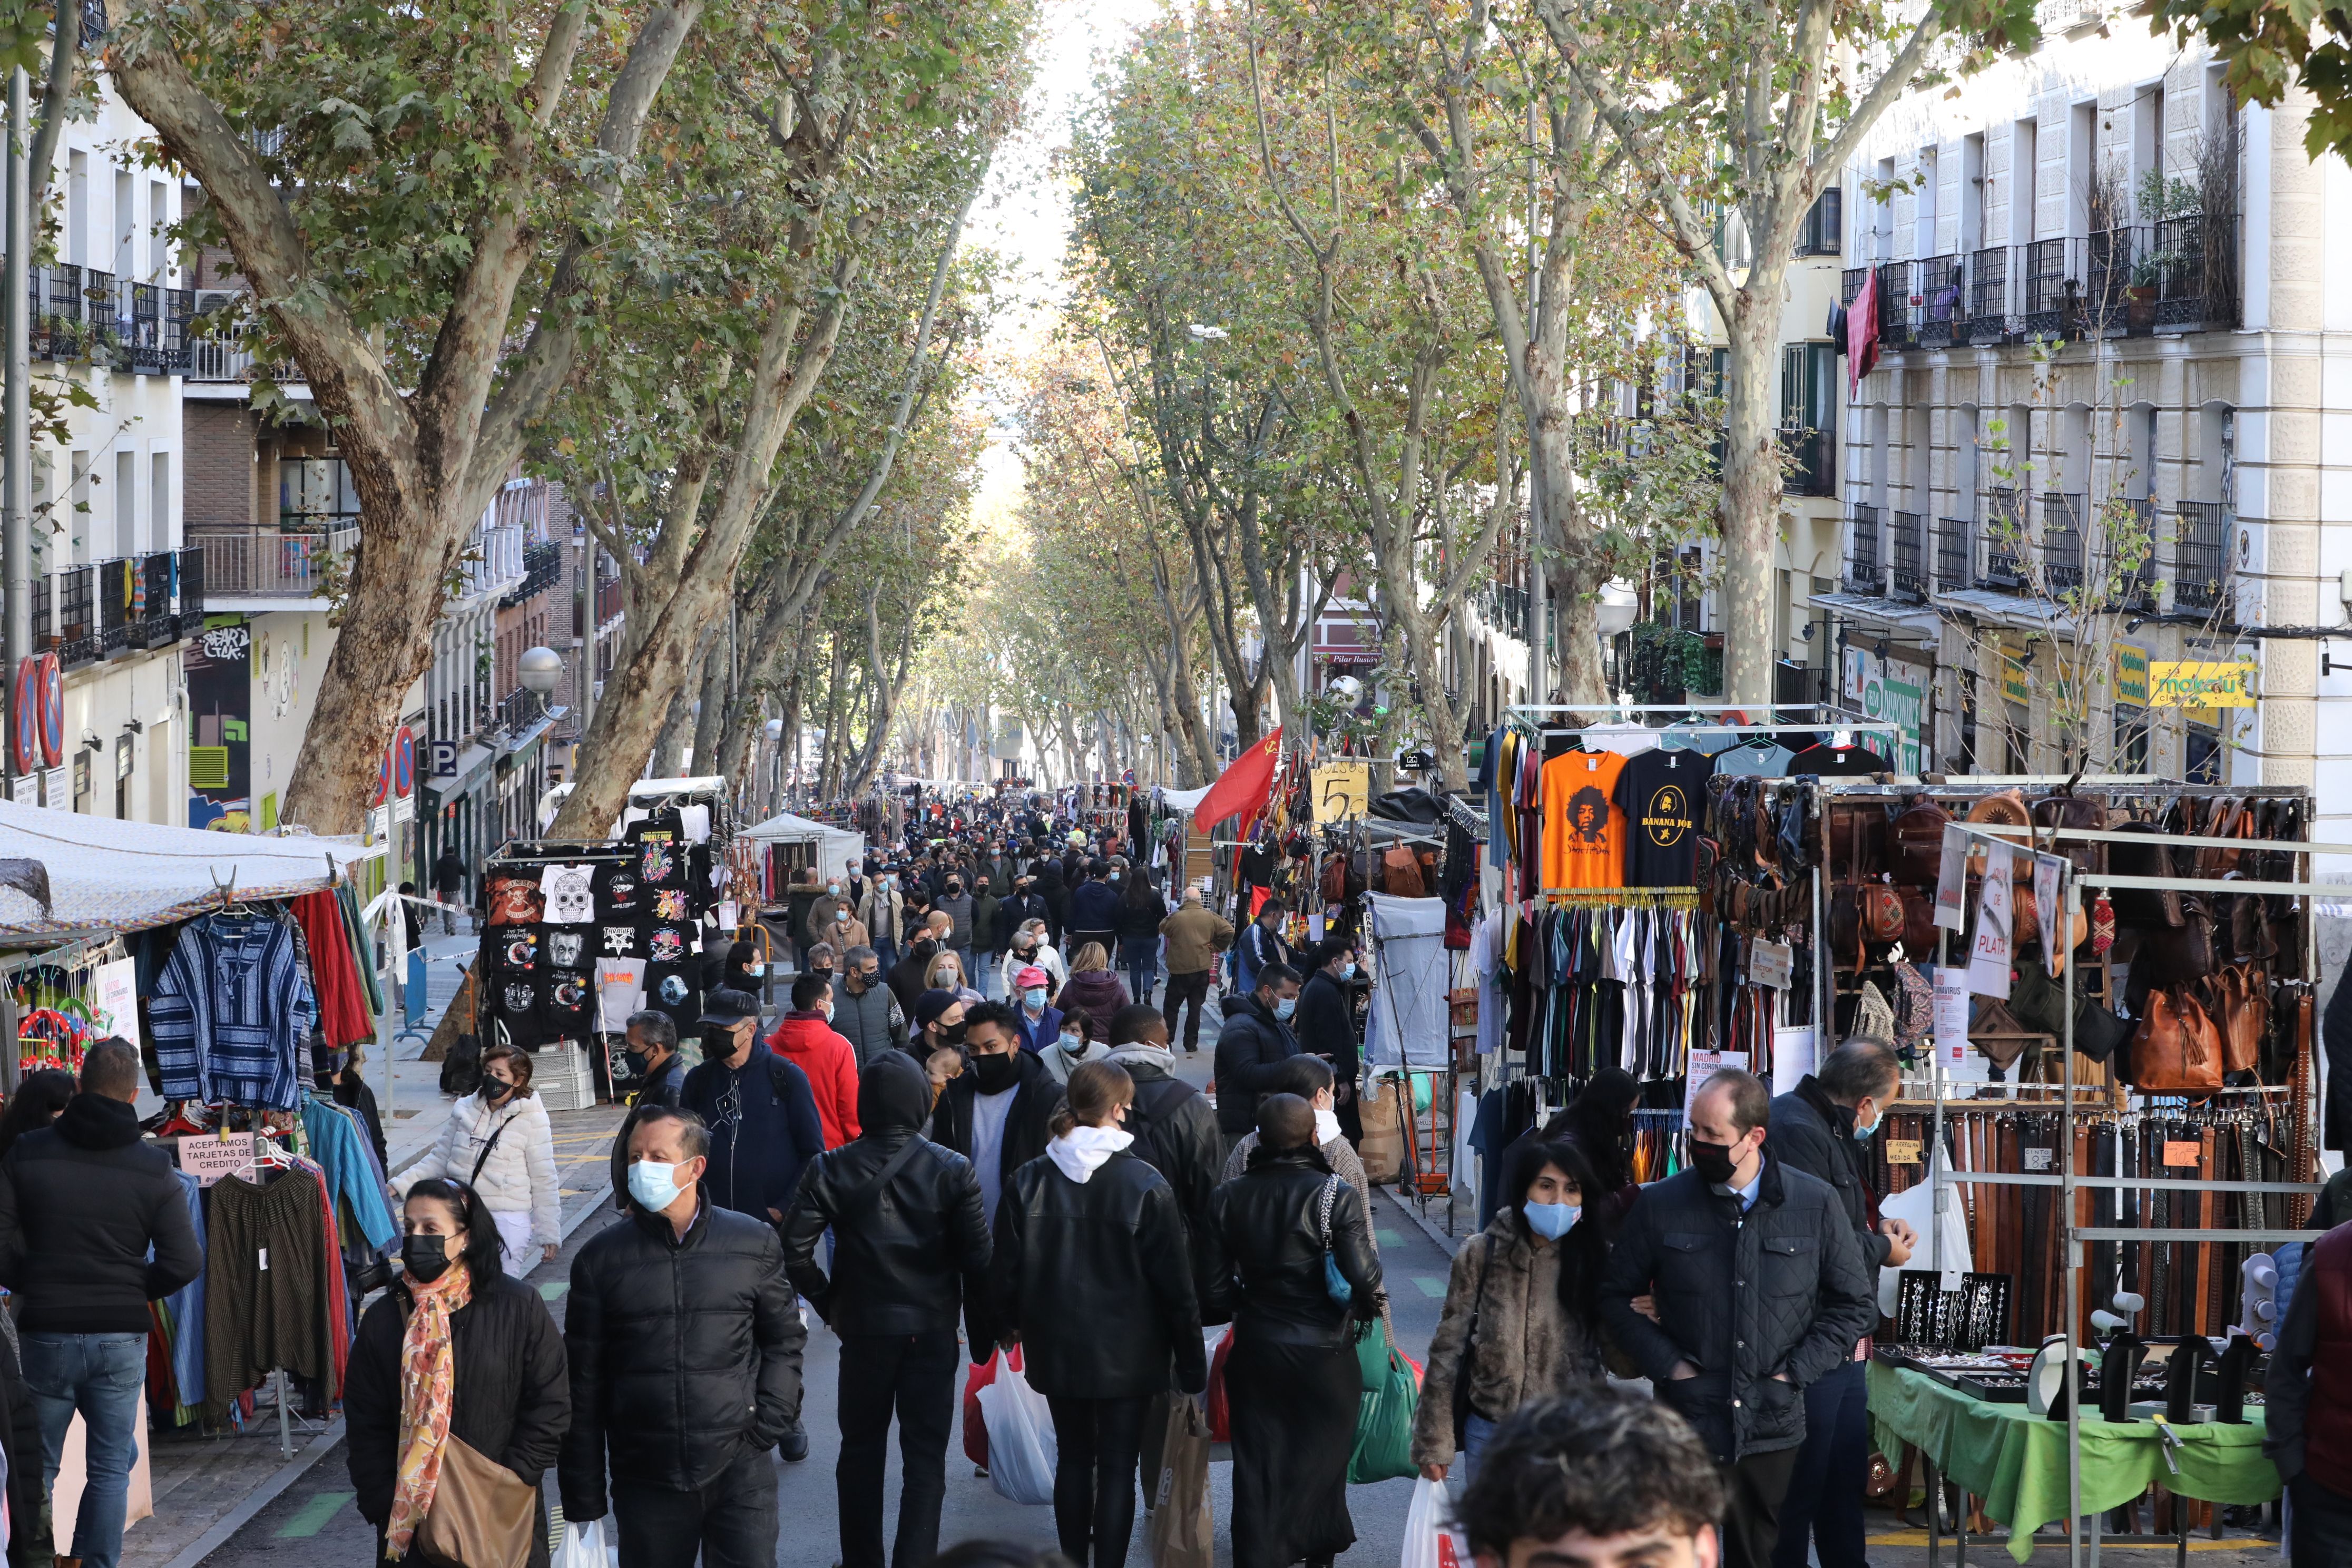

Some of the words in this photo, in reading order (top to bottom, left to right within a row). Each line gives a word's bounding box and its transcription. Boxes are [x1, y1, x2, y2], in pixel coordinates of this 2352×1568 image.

[2121, 651, 2145, 672] alpinismo
[2159, 675, 2236, 693] makalu
[2121, 680, 2145, 700] escalada
[433, 746, 455, 773] P
[1642, 818, 1675, 827] BANANA
[1677, 819, 1692, 829] JOE
[523, 880, 537, 890] DEAD
[1994, 894, 2001, 906] DE
[505, 907, 535, 918] SURVIVOR
[603, 927, 635, 939] THRASHER
[1978, 935, 2006, 956] PLATA
[1753, 964, 1772, 974] SECTOR
[1692, 1053, 1721, 1063] MADRID
[189, 1139, 248, 1150] ACEPTAMOS
[187, 1150, 236, 1160] TARJETAS
[200, 1160, 241, 1169] CREDITO
